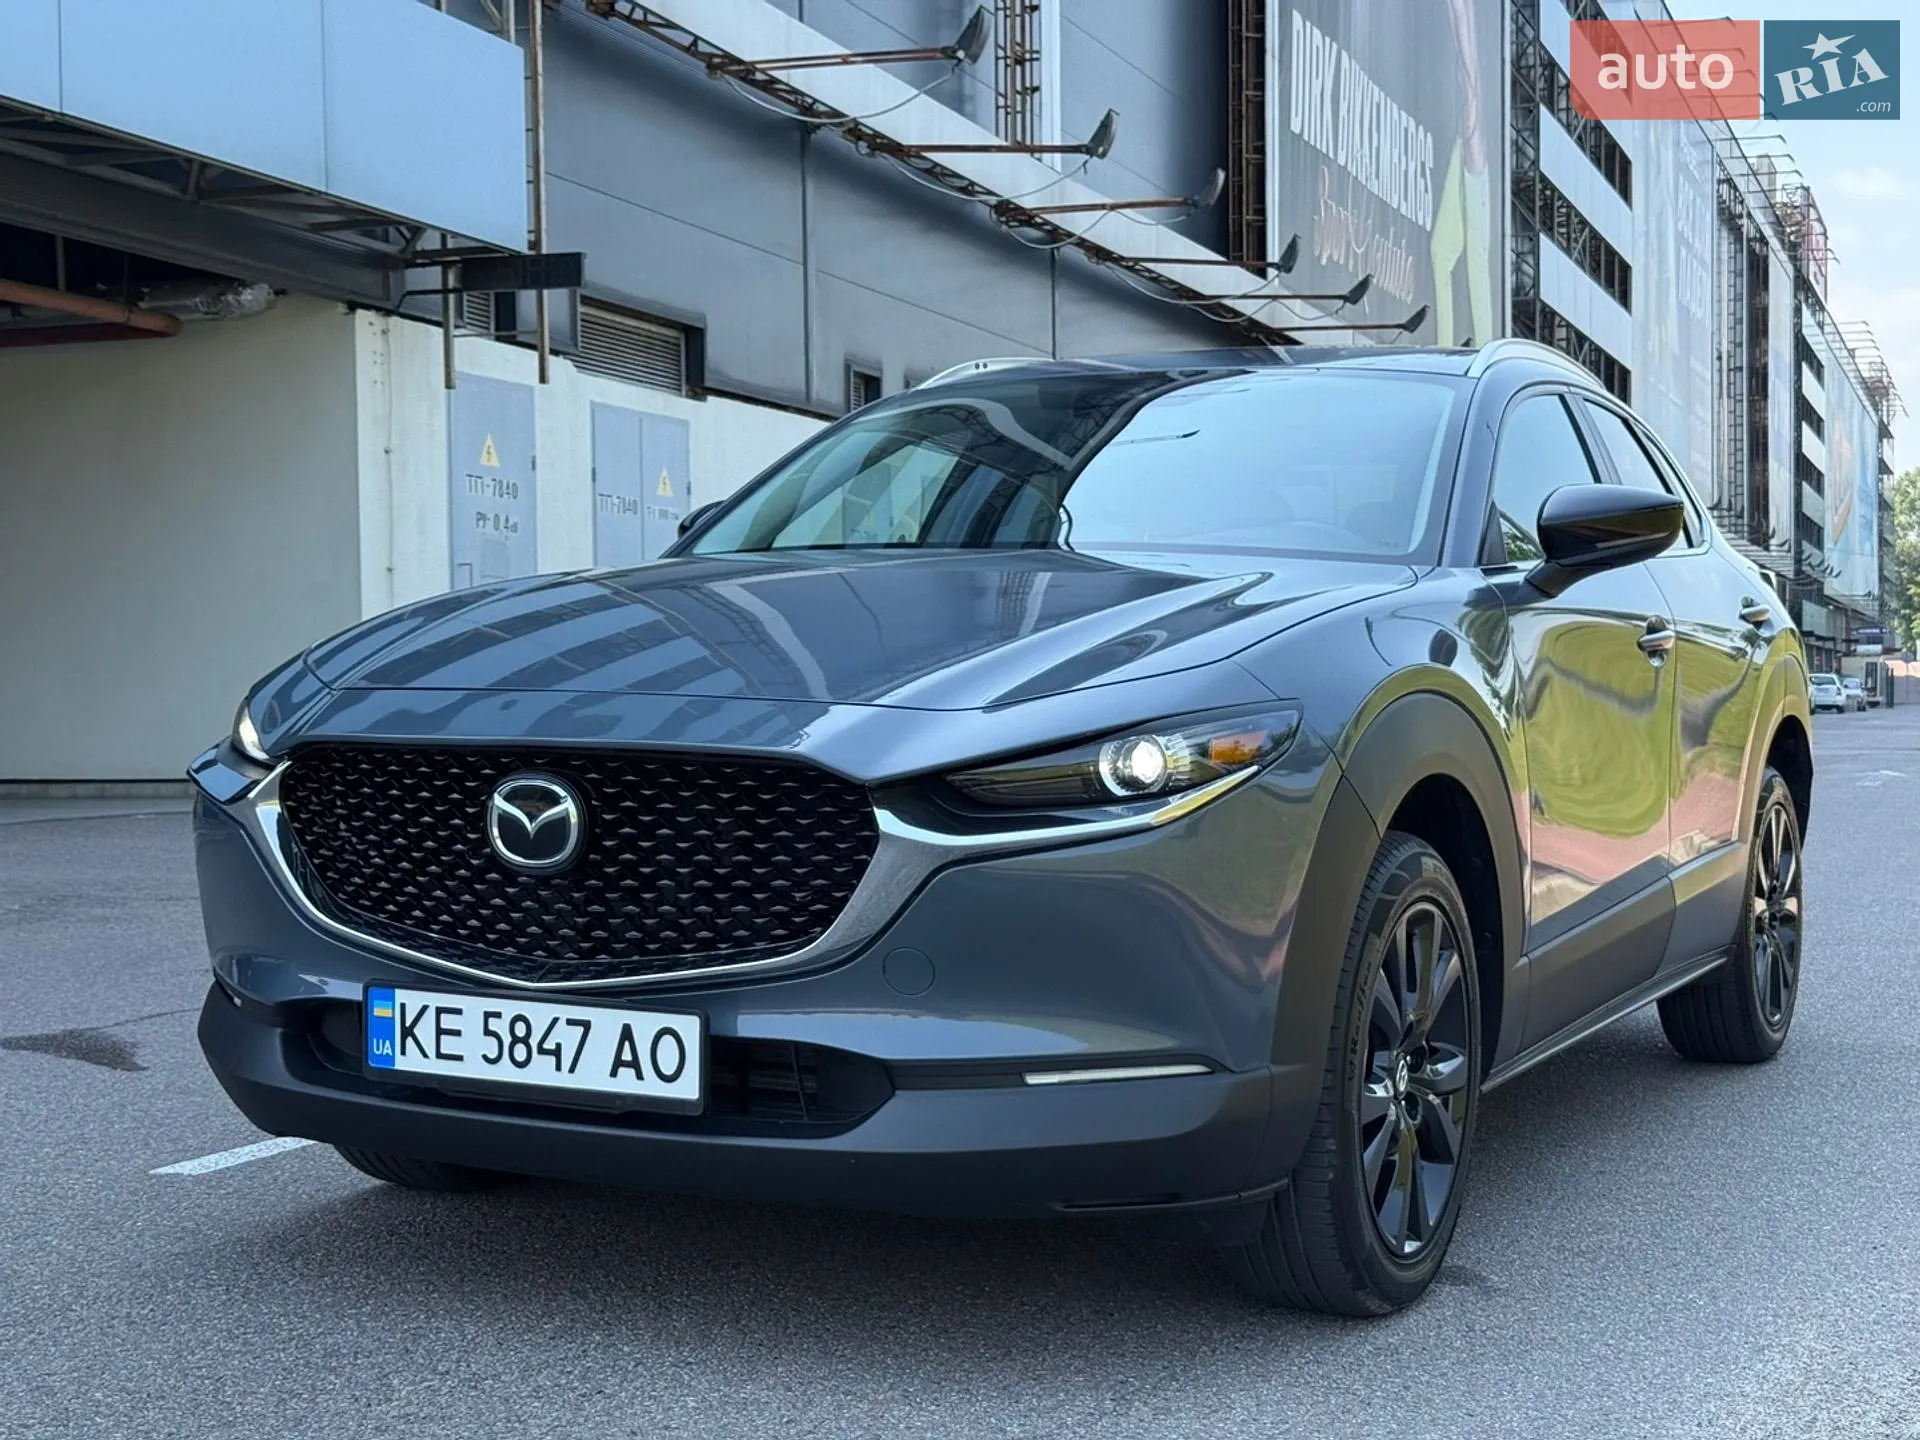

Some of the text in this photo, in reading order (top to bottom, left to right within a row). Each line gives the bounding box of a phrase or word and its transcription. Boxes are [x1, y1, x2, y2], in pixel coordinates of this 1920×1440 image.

[1290, 9, 1434, 231] DIRK BIKKEMBERGS
[373, 1038, 393, 1056] UA
[399, 1002, 686, 1085] KE 5847 AO
